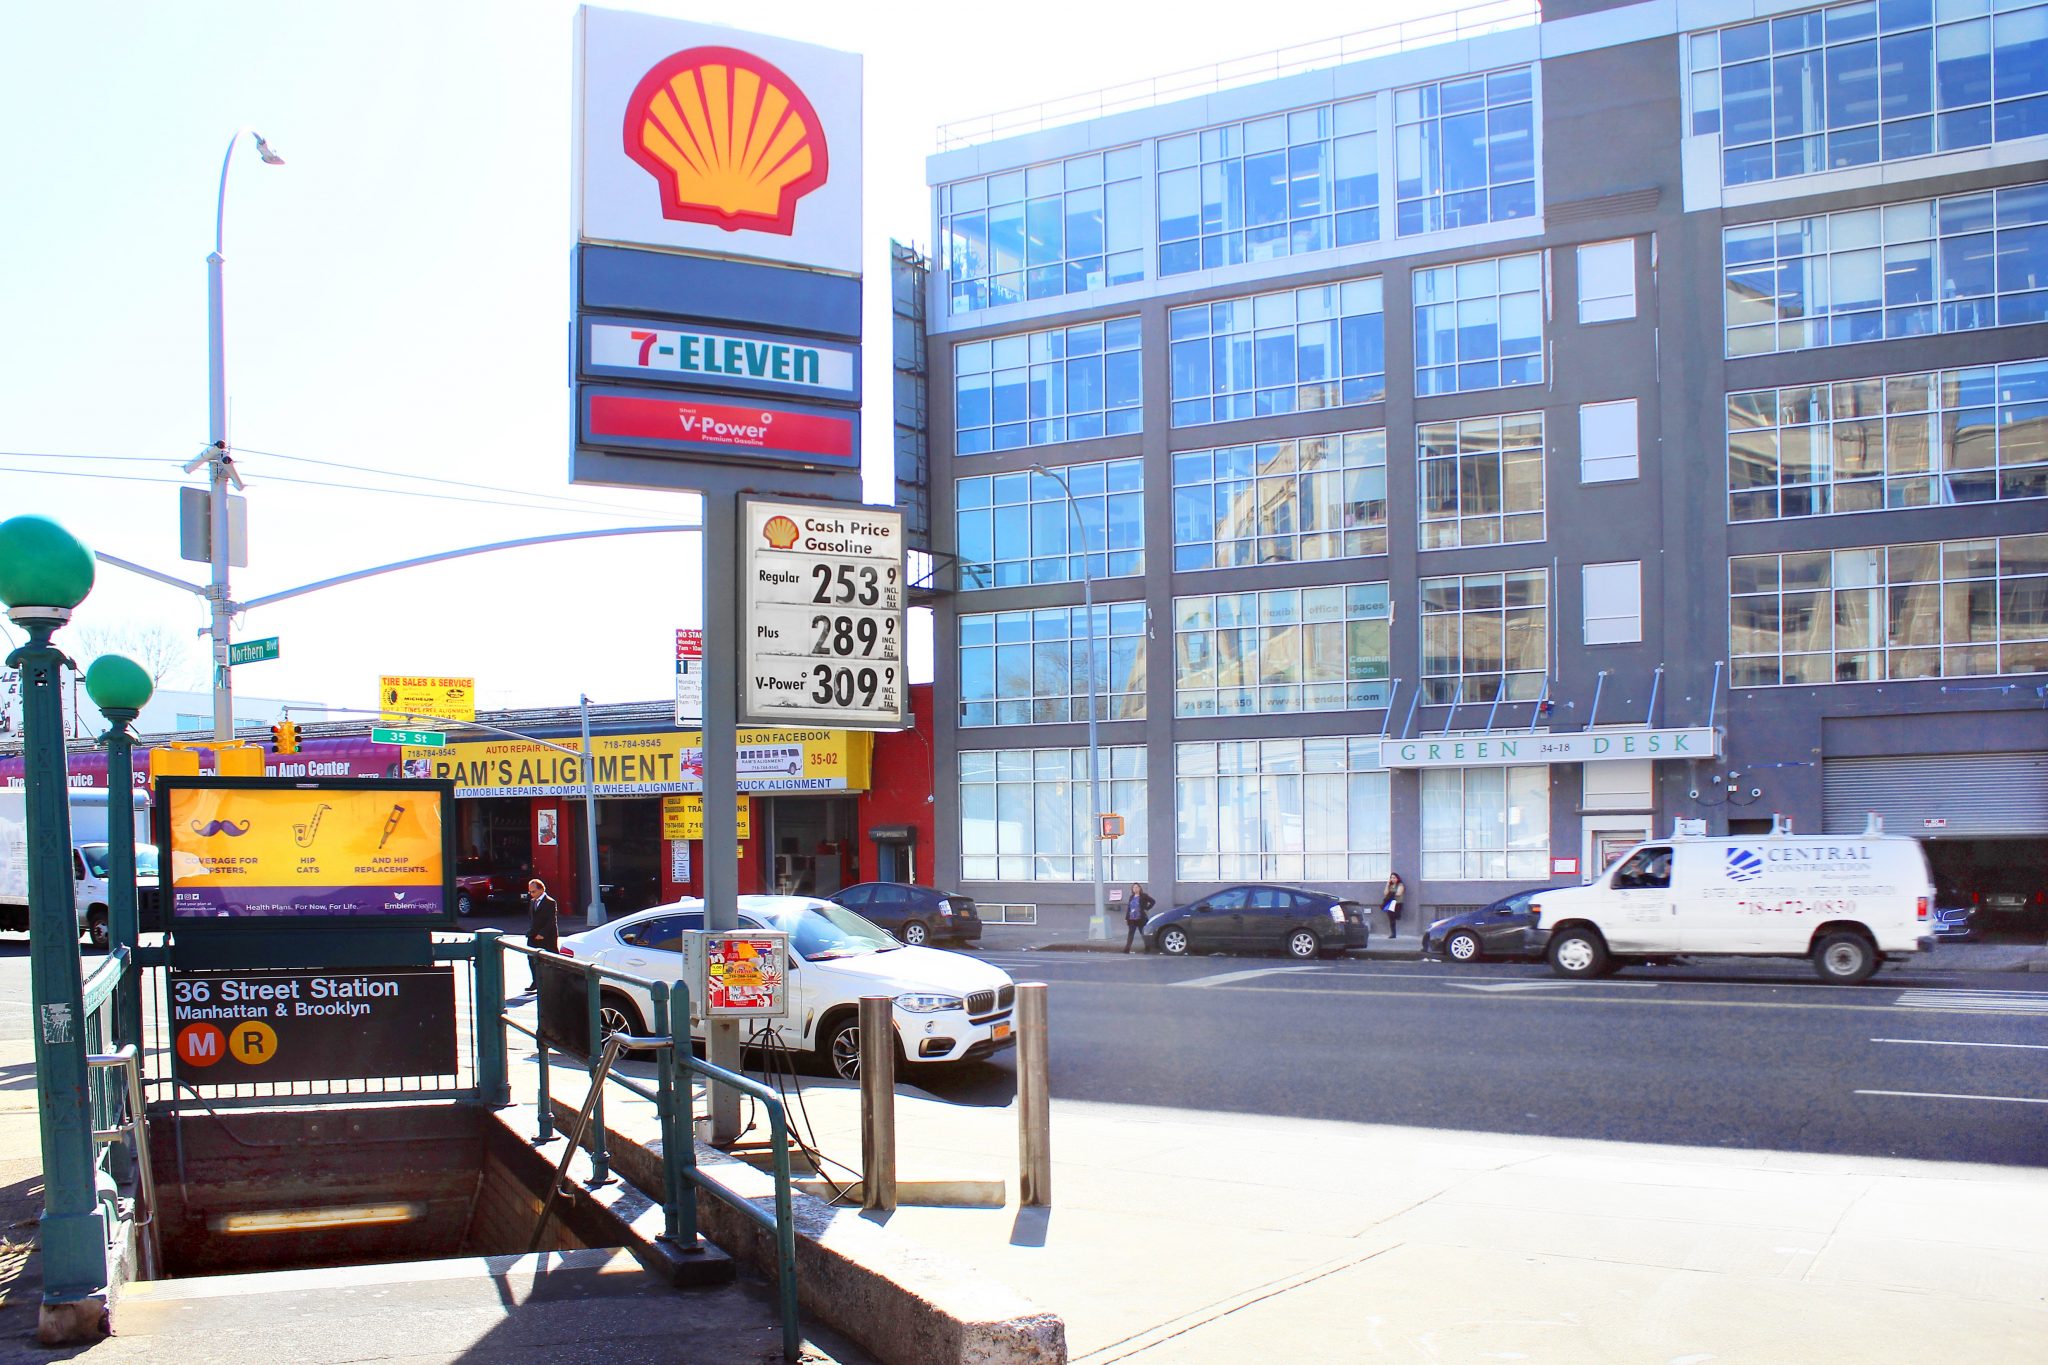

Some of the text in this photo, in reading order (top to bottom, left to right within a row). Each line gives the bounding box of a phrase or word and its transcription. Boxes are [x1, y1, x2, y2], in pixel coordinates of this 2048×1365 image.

[679, 407, 697, 415] Shell
[679, 414, 767, 438] V-Power
[701, 434, 764, 446] Premium Gasoline
[805, 518, 890, 537] Cash Price
[805, 537, 873, 554] Gasoline
[759, 570, 800, 586] Regular
[887, 567, 897, 585] 9
[1309, 605, 1339, 614] office
[1347, 603, 1384, 613] spaces
[757, 626, 779, 638] Plus
[885, 617, 895, 635] 9
[231, 639, 277, 663] Northern Blvd
[1349, 655, 1387, 663] Coming
[679, 661, 685, 673] 1
[382, 678, 400, 686] TIRE
[402, 678, 427, 686] SALES
[439, 679, 472, 687] SERVICE
[756, 676, 806, 691] V-Power
[885, 667, 895, 684] 9
[390, 732, 428, 743] 35 St
[739, 731, 831, 743] US ON FACEBOOK
[407, 739, 662, 758] 718-784-9545 AUTO REPAIR CETER 718-784-9545
[1401, 734, 1689, 761] GREEN 34-18 DESK
[279, 763, 306, 777] Auto
[308, 760, 350, 776] Center
[436, 759, 513, 786] RAM'S
[811, 753, 838, 765] 35-02
[67, 773, 94, 787] rvice
[736, 779, 832, 790] RUCK ALIGNMENT
[455, 782, 694, 797] UTOMOBILE REPAIRS COMPUTR WHEEL ALIGNMENT
[1767, 847, 1872, 862] CENTRAL
[296, 866, 320, 874] CATS
[1767, 863, 1872, 872] CONSTRUCTION
[384, 902, 437, 910] EmblemHealth
[175, 977, 399, 1002] 36 Street Station
[175, 1001, 371, 1020] Manhattan & Brooklyn
[188, 1031, 264, 1057] M R
